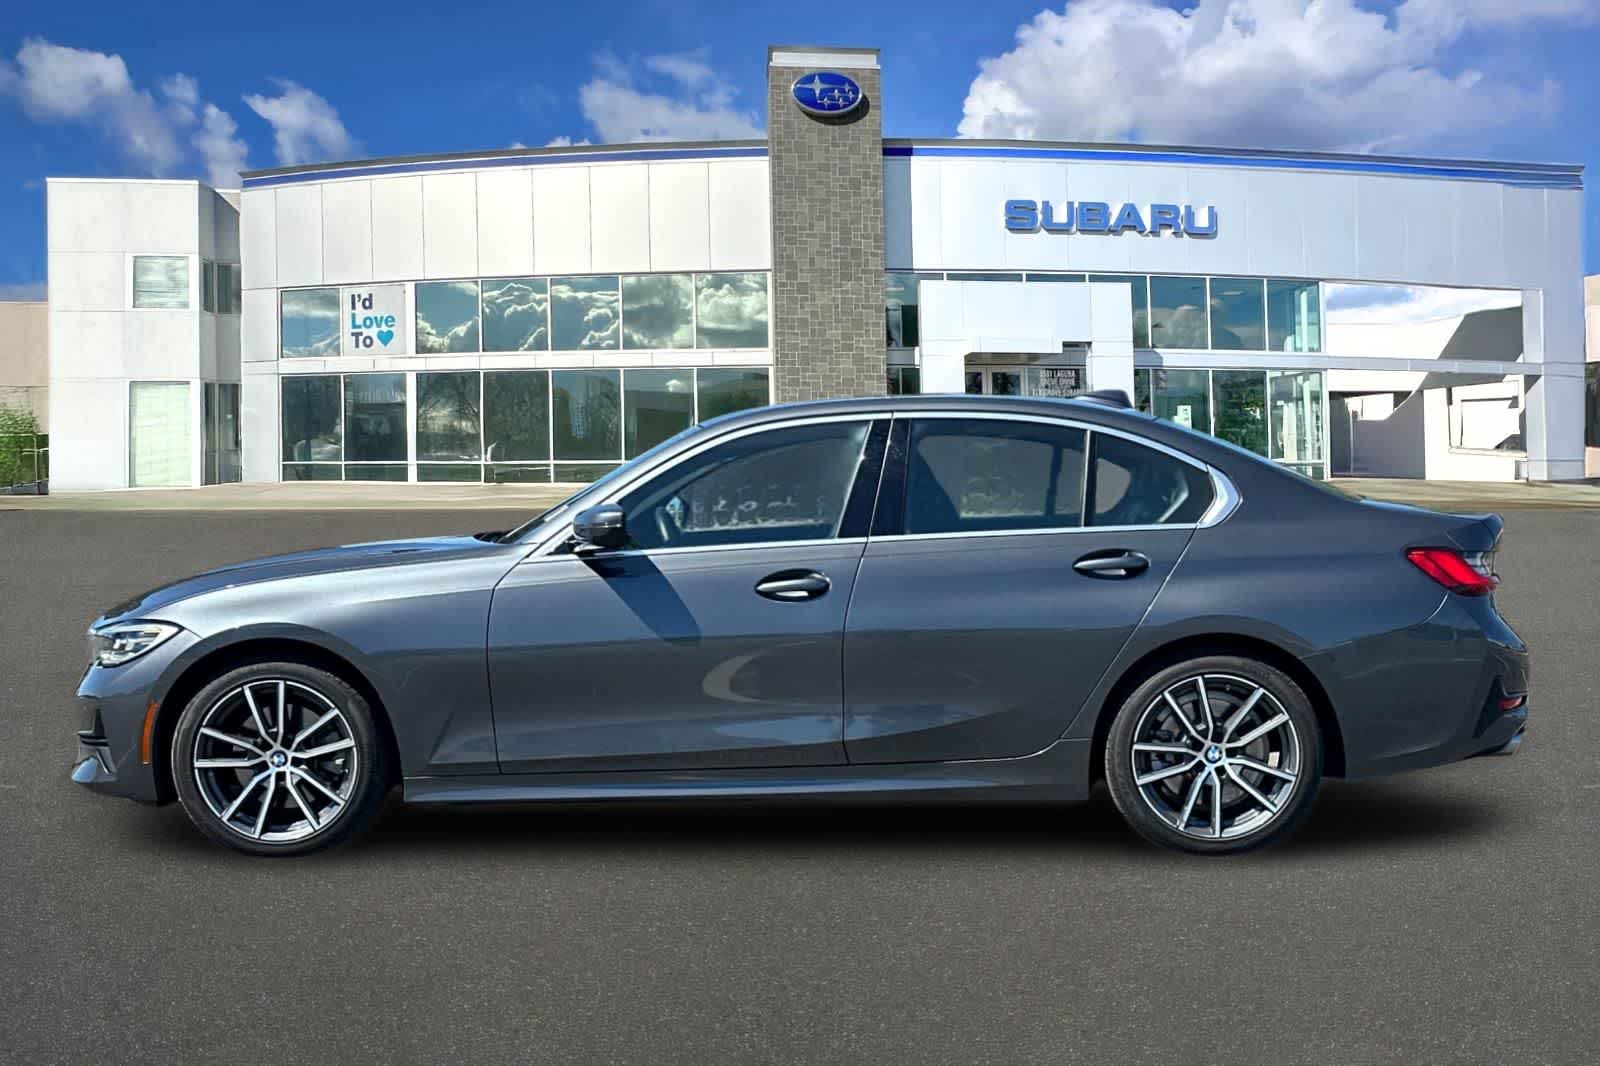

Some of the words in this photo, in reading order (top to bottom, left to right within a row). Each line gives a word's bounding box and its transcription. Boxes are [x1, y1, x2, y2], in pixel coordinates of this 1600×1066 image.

[1004, 199, 1217, 238] SUBARU
[351, 293, 373, 310] I'd
[351, 313, 396, 329] Love
[351, 332, 373, 348] To
